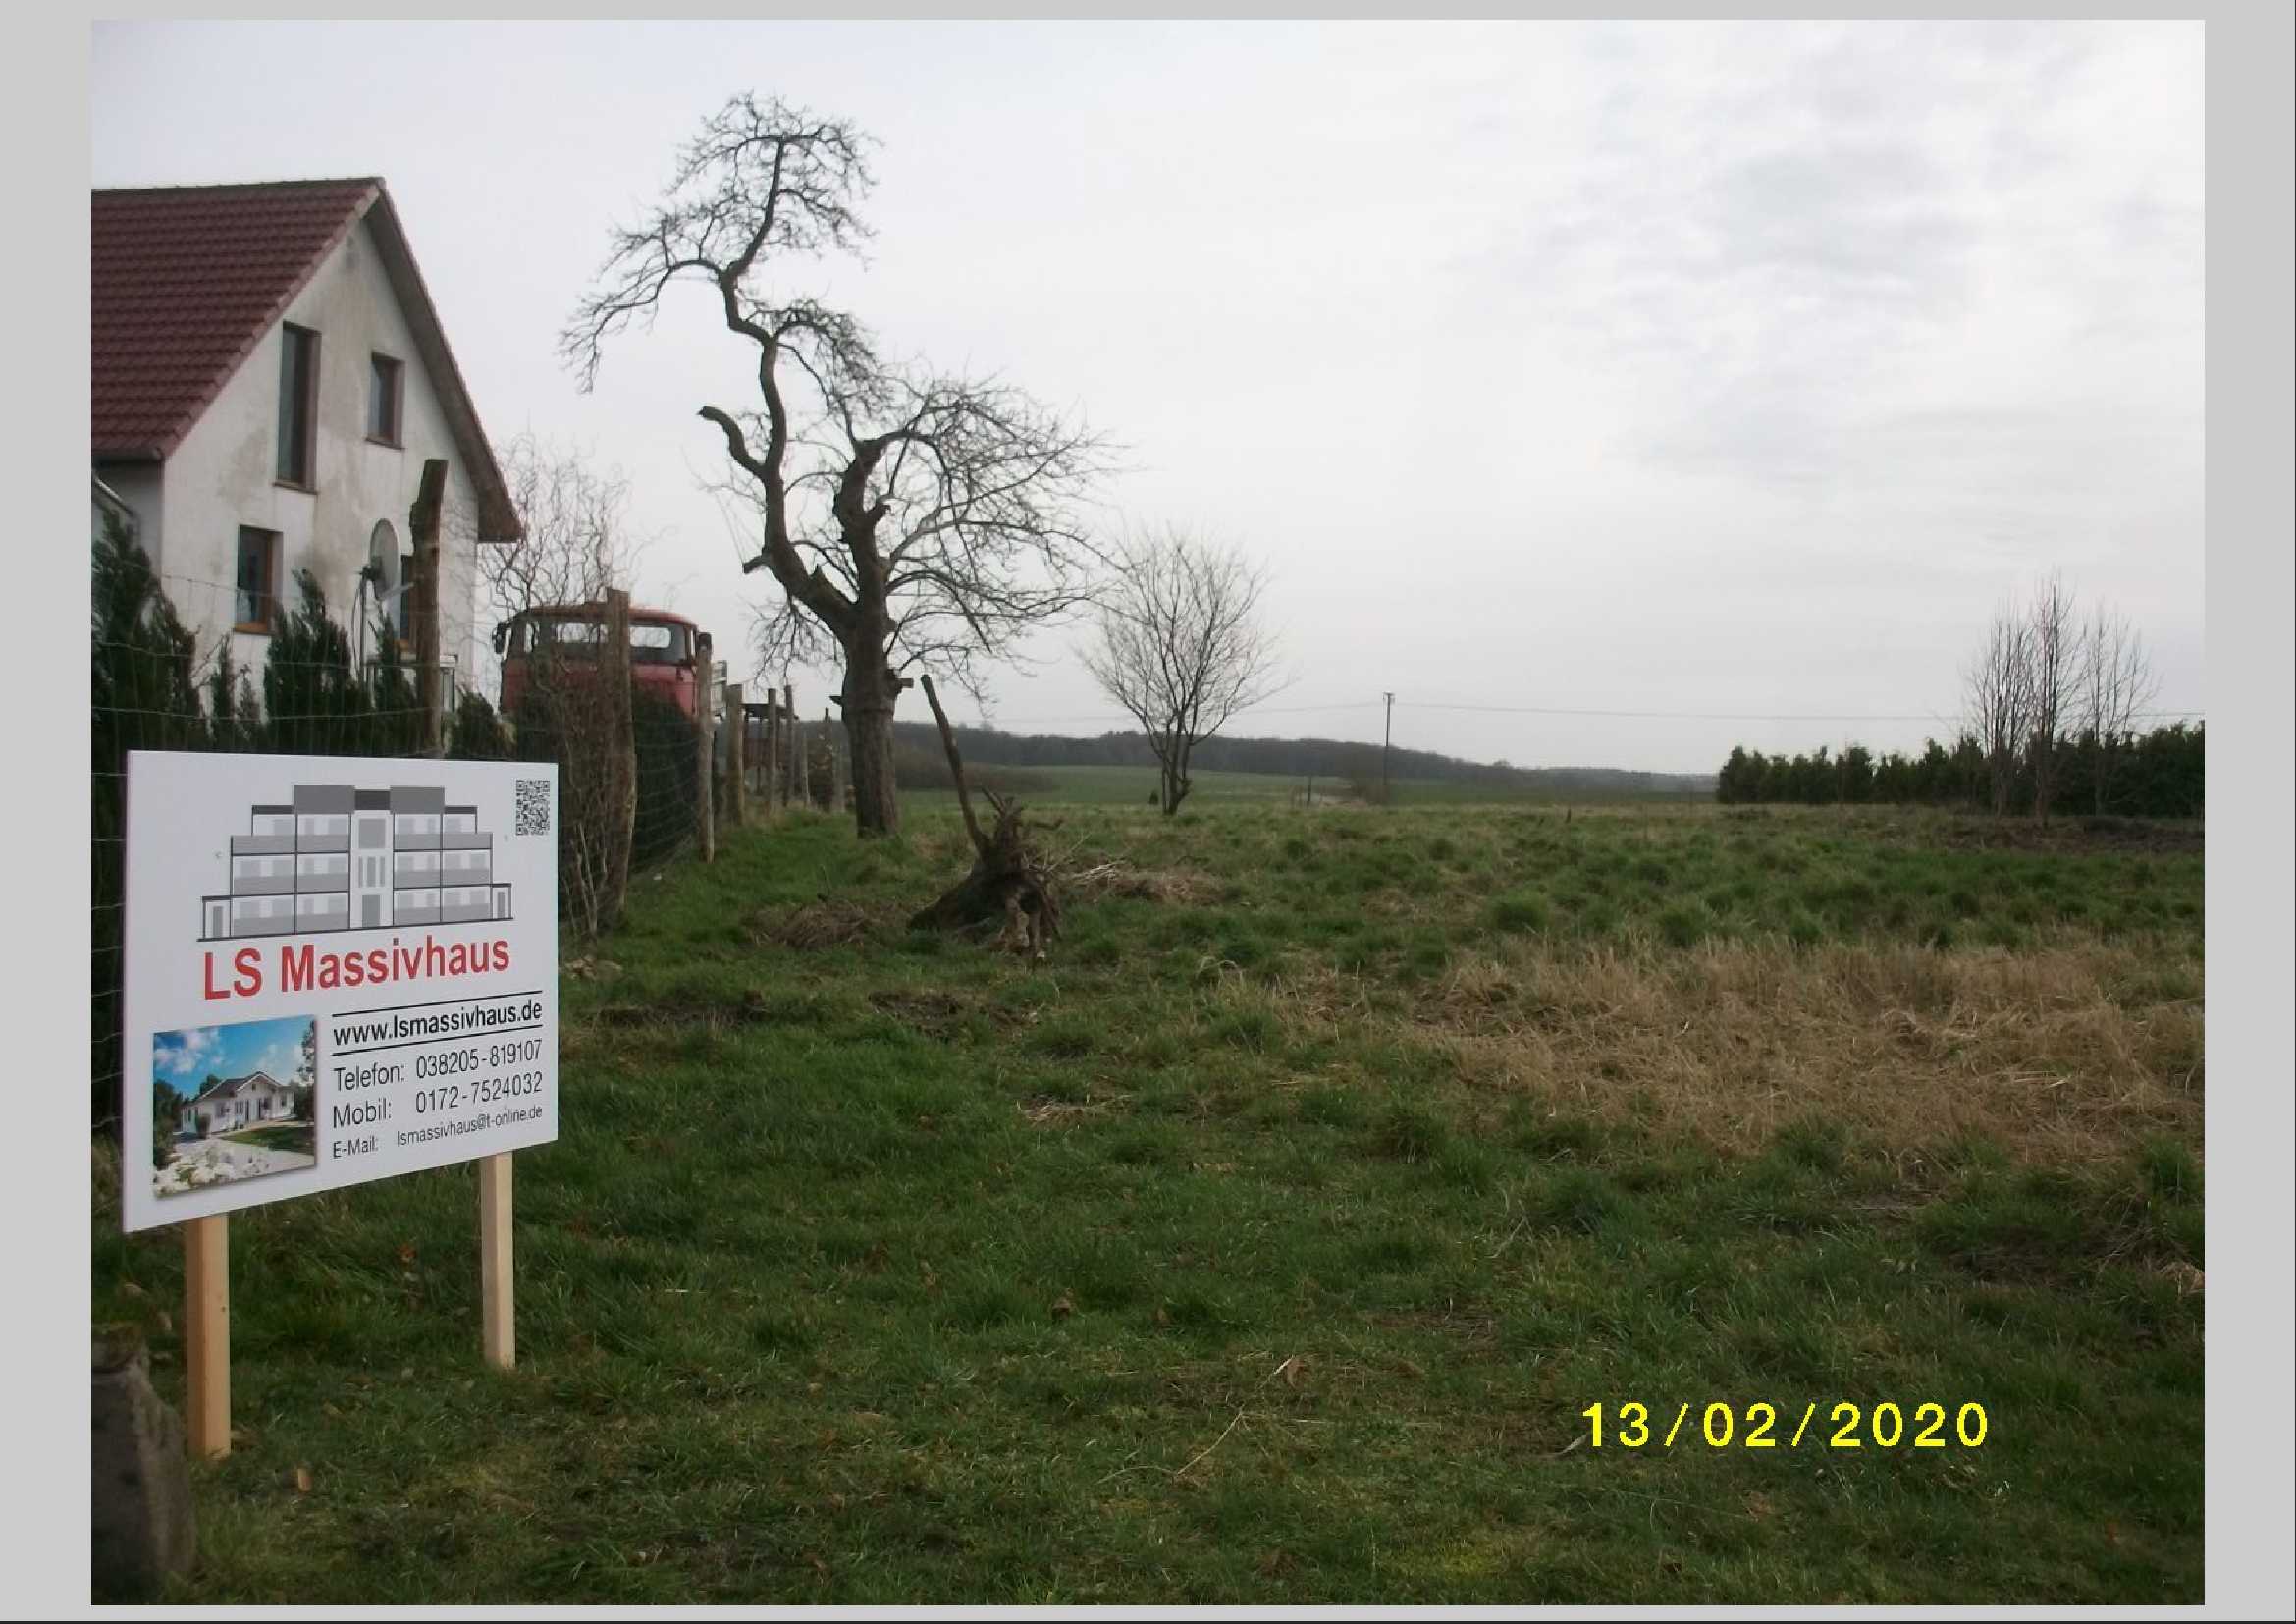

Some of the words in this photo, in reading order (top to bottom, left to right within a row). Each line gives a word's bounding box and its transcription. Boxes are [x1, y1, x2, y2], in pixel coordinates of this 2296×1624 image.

[204, 947, 263, 1000] LS
[281, 935, 510, 993] Massivhaus
[333, 999, 543, 1046] www.lsmassivhaus.de
[334, 1063, 405, 1092] Telefon:
[333, 1099, 393, 1129] Mobil:
[333, 1135, 379, 1160] E-Mail:
[397, 1105, 543, 1147] lsmassivhaus@t-online.de
